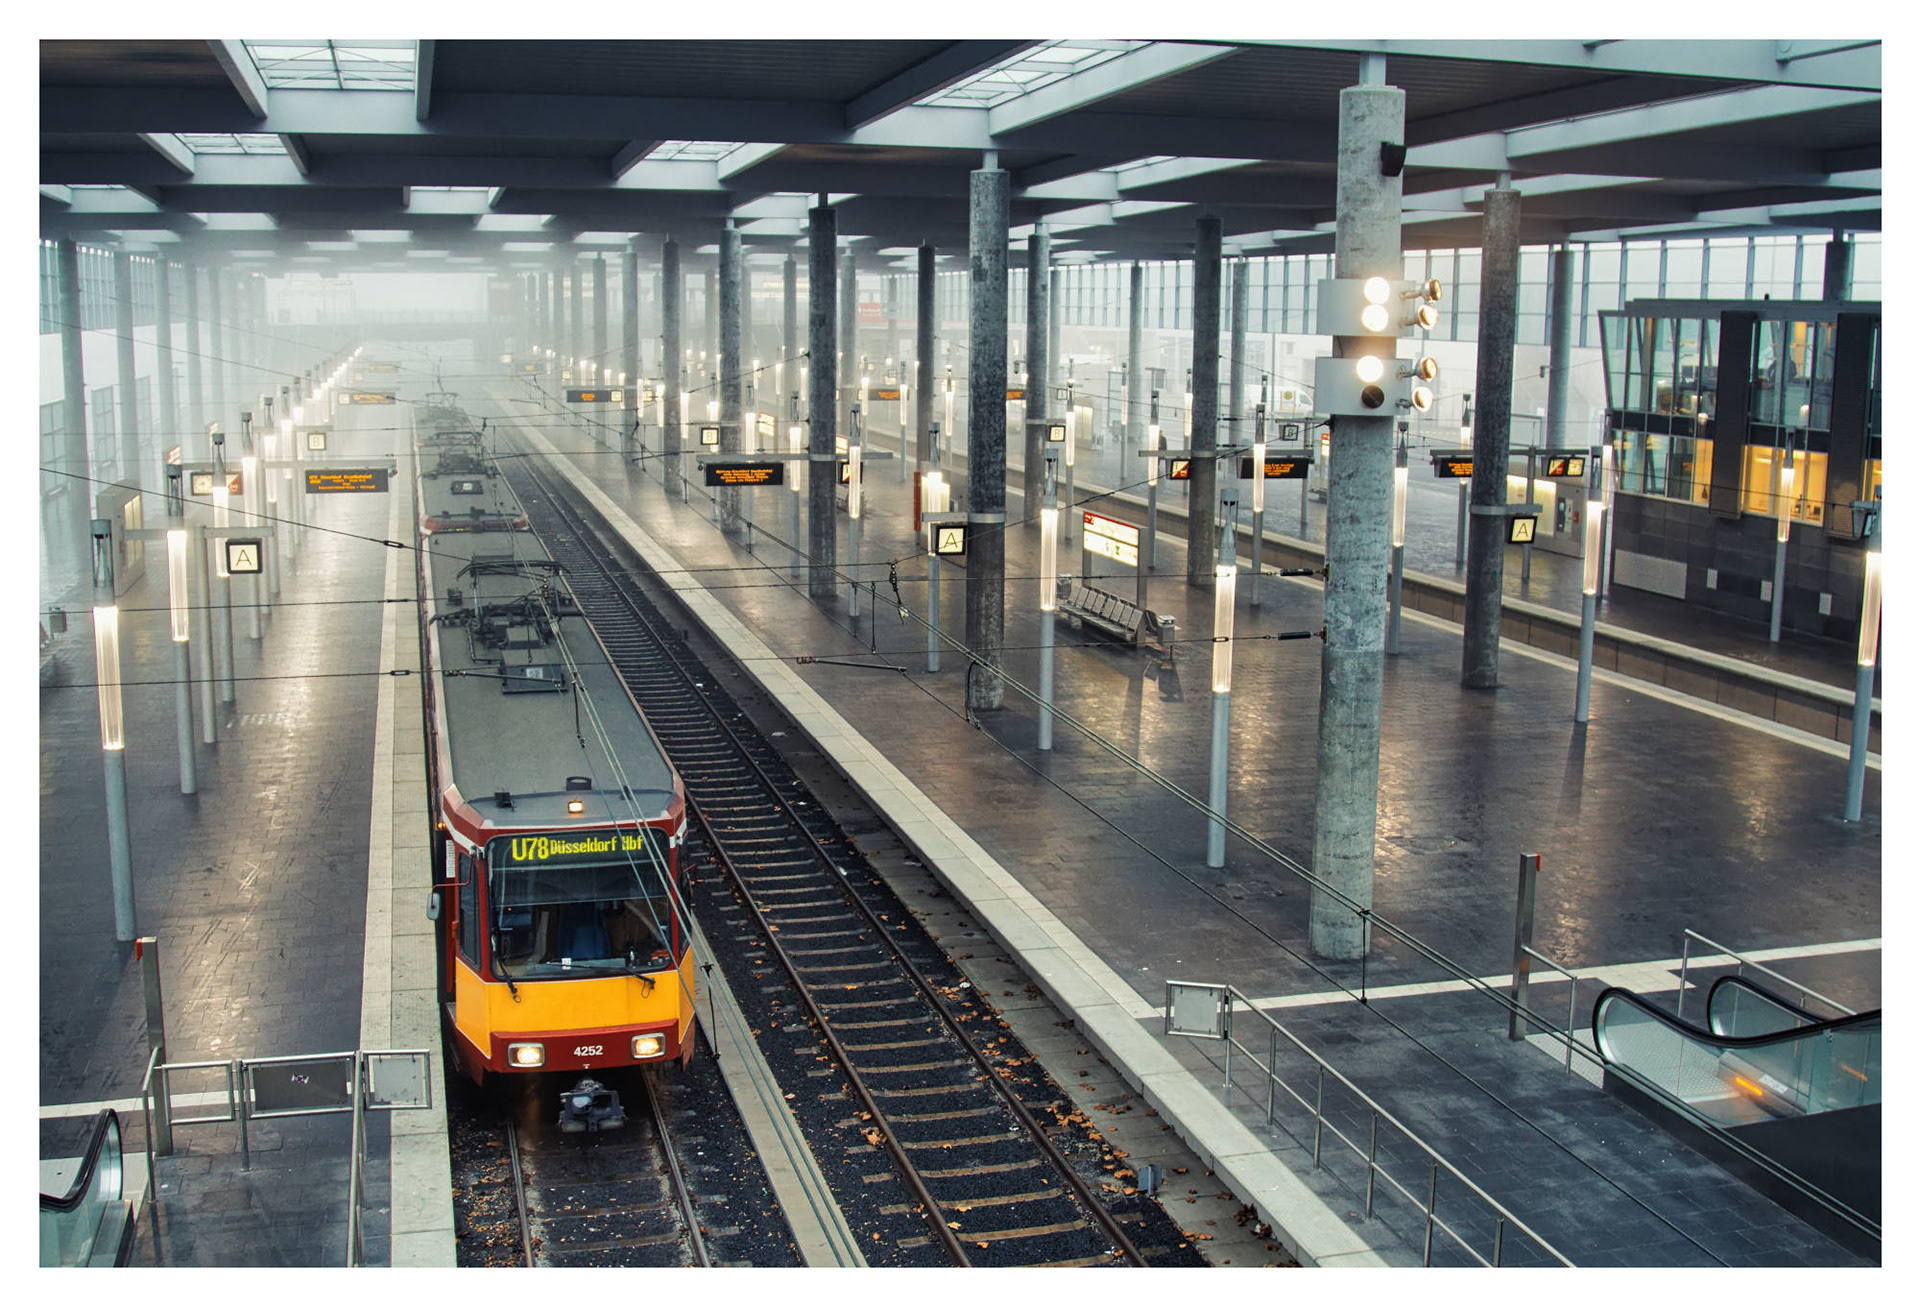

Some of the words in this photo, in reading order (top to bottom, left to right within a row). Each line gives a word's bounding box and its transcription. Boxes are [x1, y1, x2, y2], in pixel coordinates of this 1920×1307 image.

[706, 431, 713, 441] B
[1054, 429, 1061, 439] B
[313, 437, 320, 447] B
[1515, 522, 1528, 538] A
[943, 532, 958, 548] A
[236, 549, 252, 566] A
[512, 837, 549, 861] U78
[550, 836, 617, 855] Düsseldorf
[621, 835, 643, 851] Hbf
[573, 1045, 604, 1056] 4252
